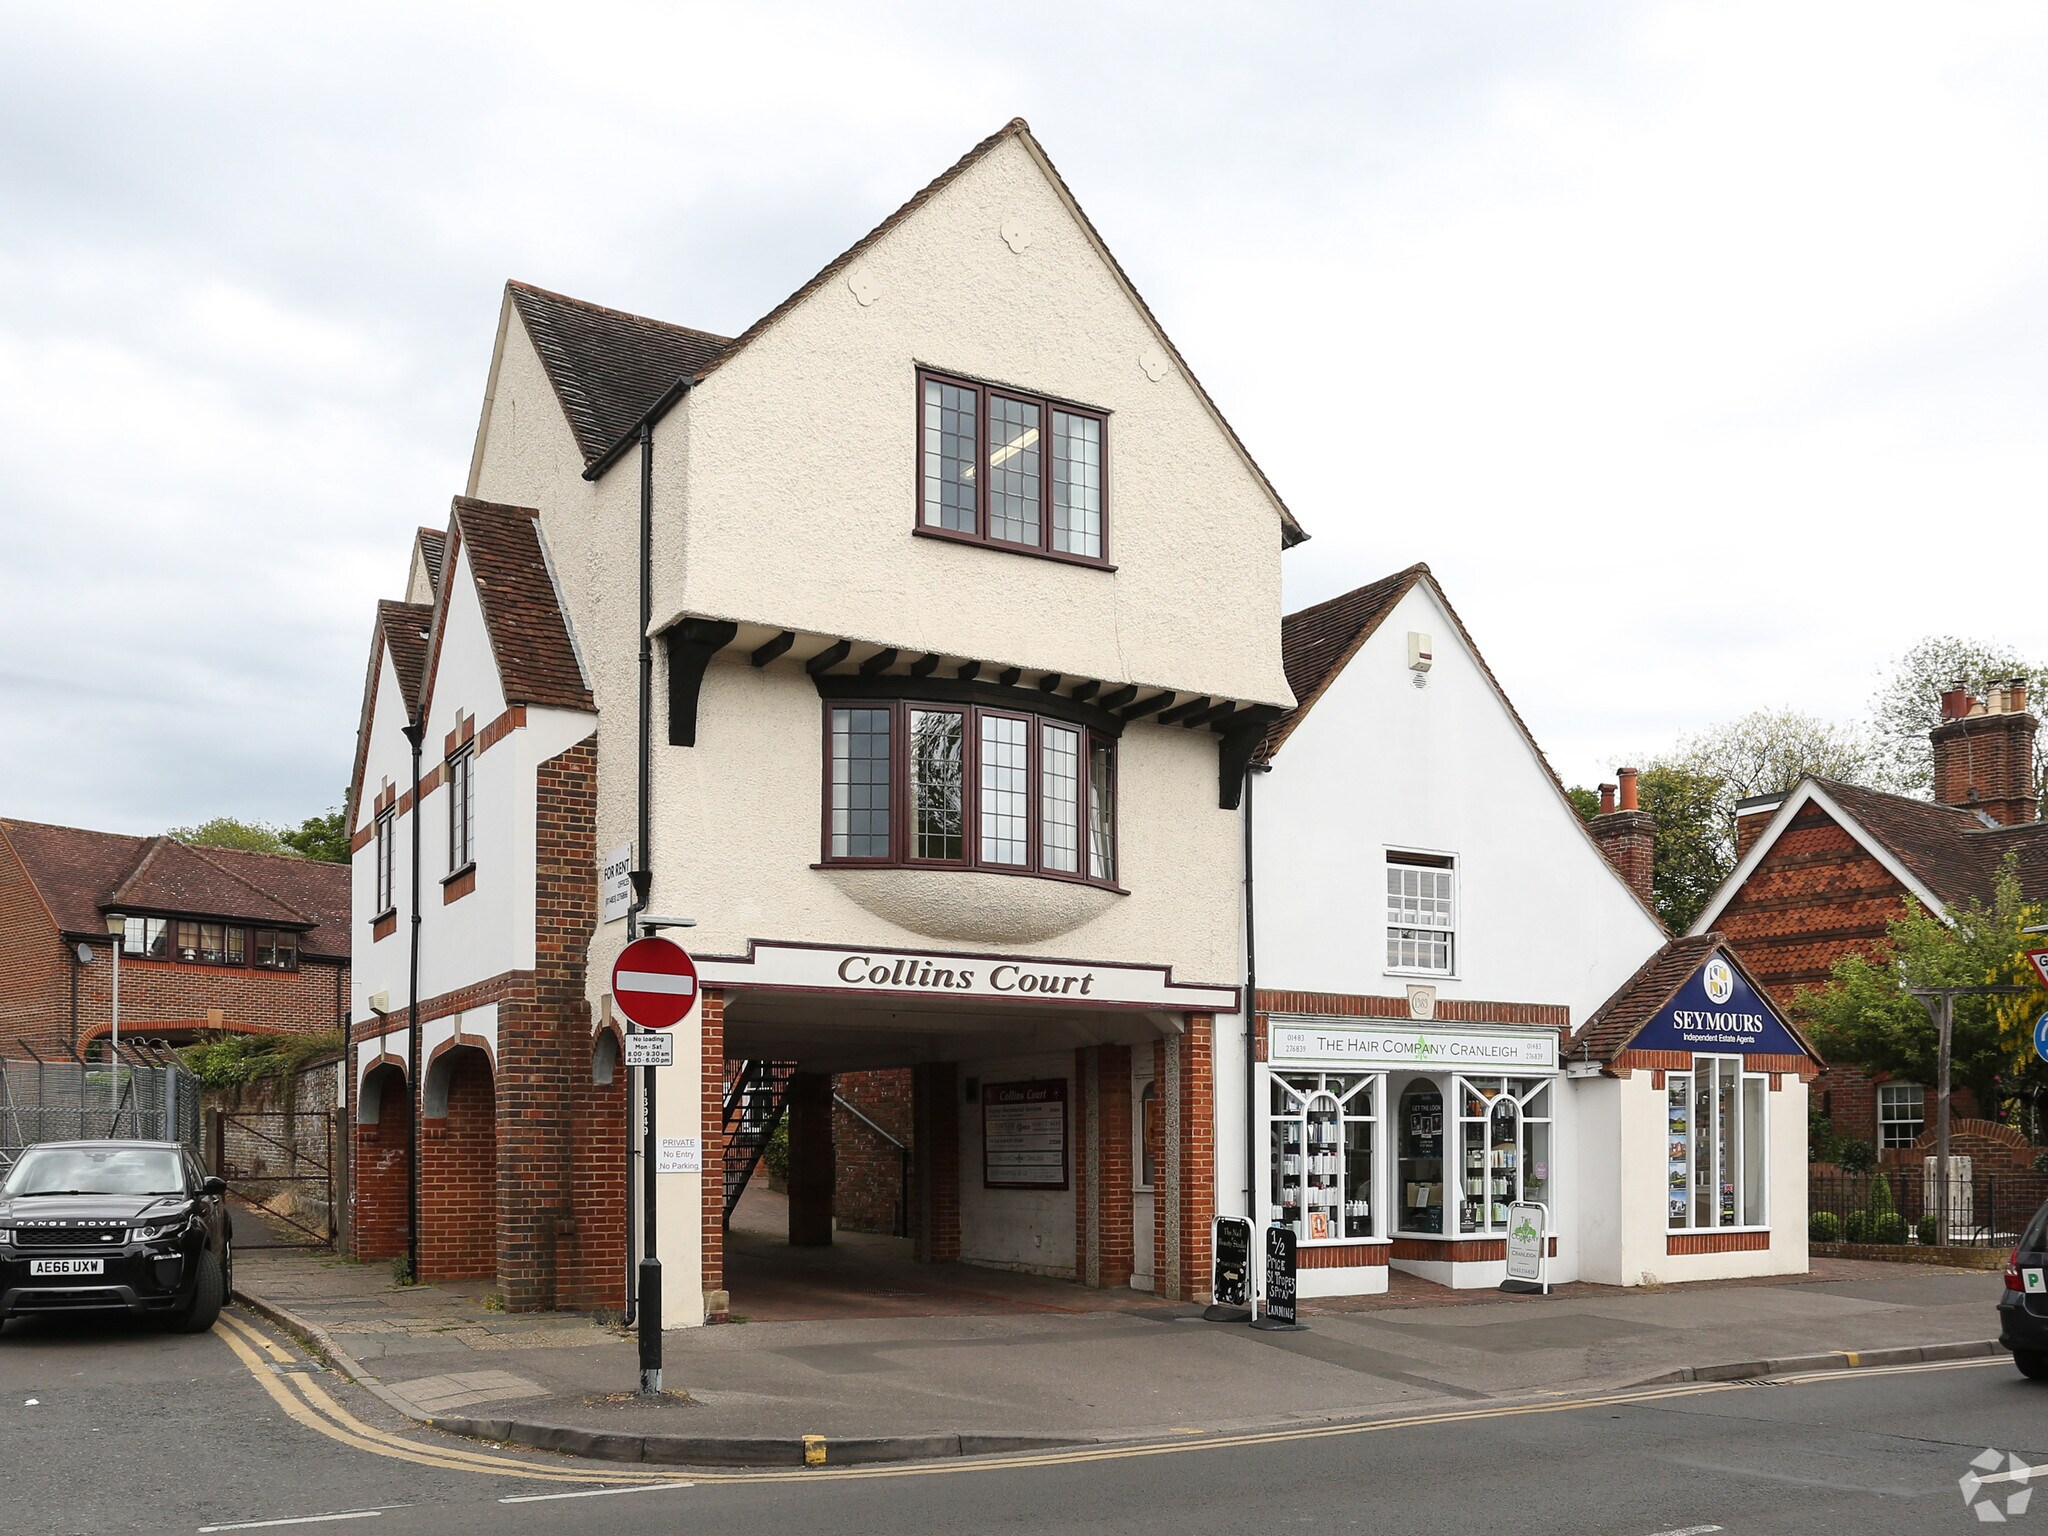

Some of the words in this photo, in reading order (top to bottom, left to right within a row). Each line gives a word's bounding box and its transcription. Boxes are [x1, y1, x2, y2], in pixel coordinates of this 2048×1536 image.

[604, 865, 614, 881] FOR
[616, 858, 629, 877] RENT
[837, 956, 975, 989] Collins
[989, 964, 1095, 995] Court
[1673, 1010, 1763, 1033] SEYMOURS
[1287, 1034, 1305, 1042] 01483
[1683, 1033, 1718, 1043] Independent
[1718, 1034, 1736, 1043] Estate
[1736, 1035, 1755, 1045] Agents
[1286, 1045, 1307, 1053] 276839
[1317, 1037, 1344, 1051] THE
[1347, 1038, 1379, 1052] HAIR
[1382, 1040, 1447, 1055] COMPANY
[1450, 1042, 1518, 1057] CRANLEIGH
[1000, 1090, 1024, 1101] Collins
[1026, 1089, 1047, 1100] Court
[675, 1150, 694, 1159] Entry
[659, 1162, 670, 1170] No
[671, 1162, 699, 1171] Parking
[1271, 1230, 1286, 1256] 1/2
[36, 1261, 70, 1273] AE66
[73, 1261, 98, 1272] UXW
[2027, 1273, 2039, 1287] P
